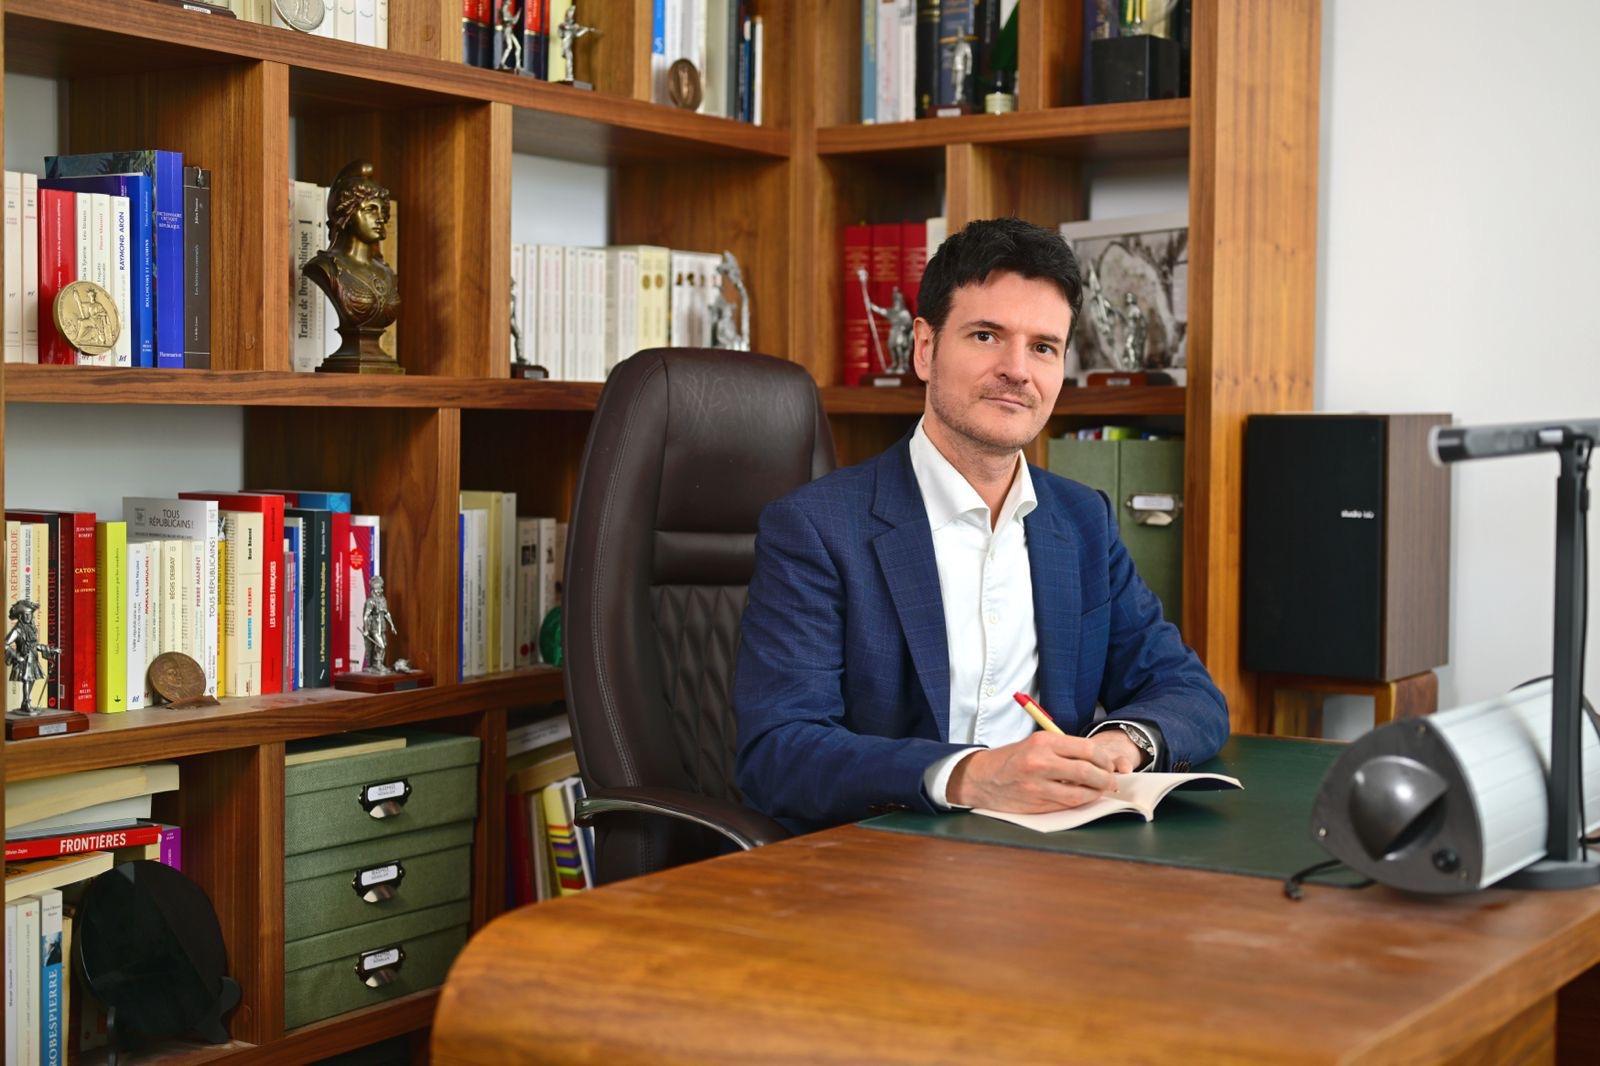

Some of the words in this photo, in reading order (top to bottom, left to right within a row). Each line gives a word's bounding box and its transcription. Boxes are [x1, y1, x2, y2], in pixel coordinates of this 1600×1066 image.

[298, 273, 308, 296] Droi
[298, 299, 308, 310] de
[298, 312, 308, 339] Traité
[163, 509, 180, 518] TOUS
[8, 528, 18, 591] RÉPUBLIQUE
[269, 560, 277, 592] FRANÇAISES
[48, 970, 58, 1066] ROBESPIERRE
